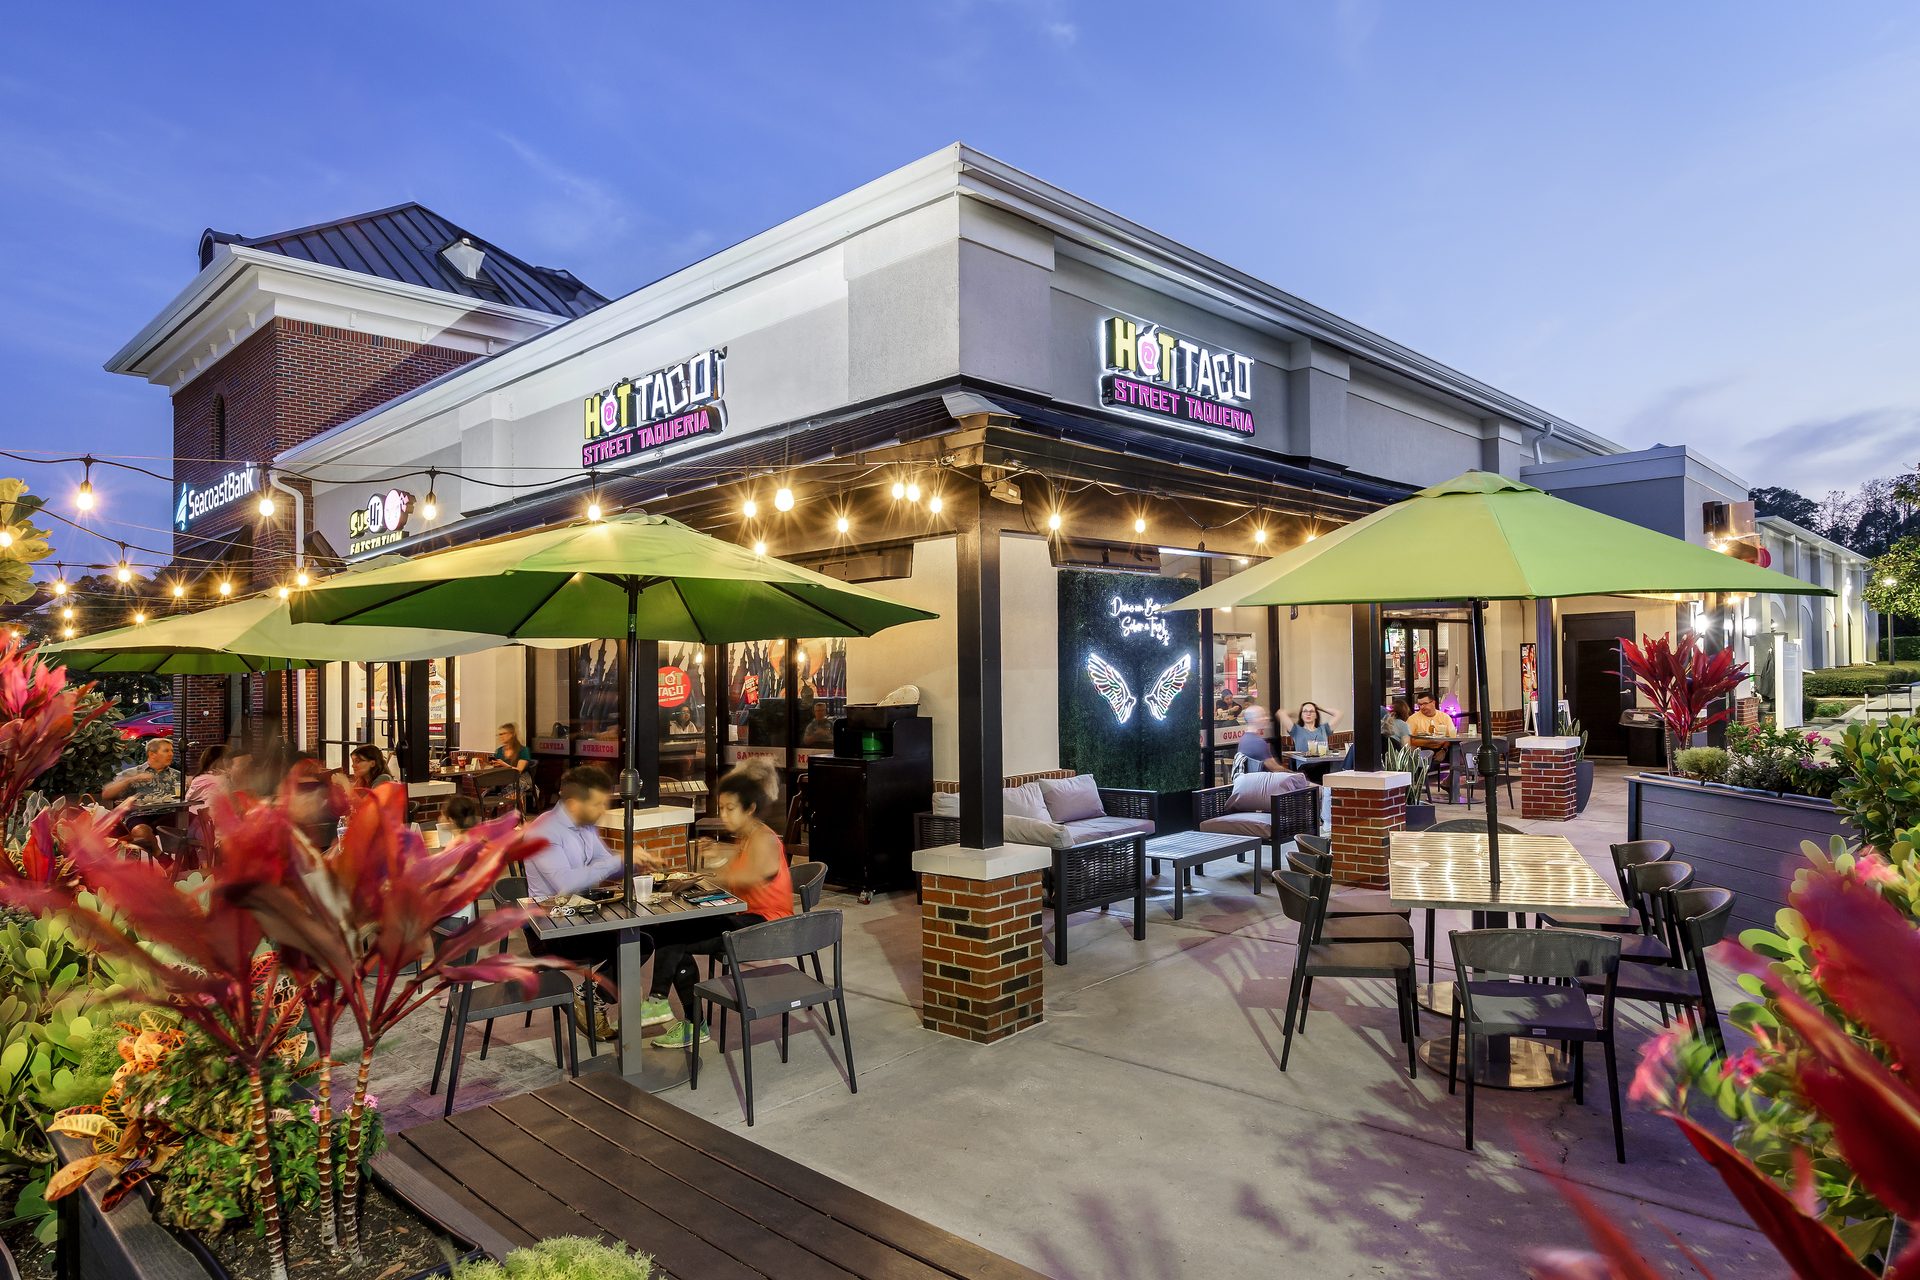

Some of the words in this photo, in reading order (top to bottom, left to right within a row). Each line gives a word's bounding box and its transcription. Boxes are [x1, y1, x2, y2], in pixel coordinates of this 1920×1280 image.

[1115, 317, 1175, 383] HOT
[1179, 339, 1252, 401] TACO
[585, 382, 631, 440] HOT
[636, 350, 711, 422] TACO
[1114, 377, 1181, 415] STREET
[1186, 396, 1254, 434] TAQUERIA
[583, 433, 633, 466] STREET
[638, 409, 710, 450] TAQUERIA
[582, 744, 614, 753] BURRITOS
